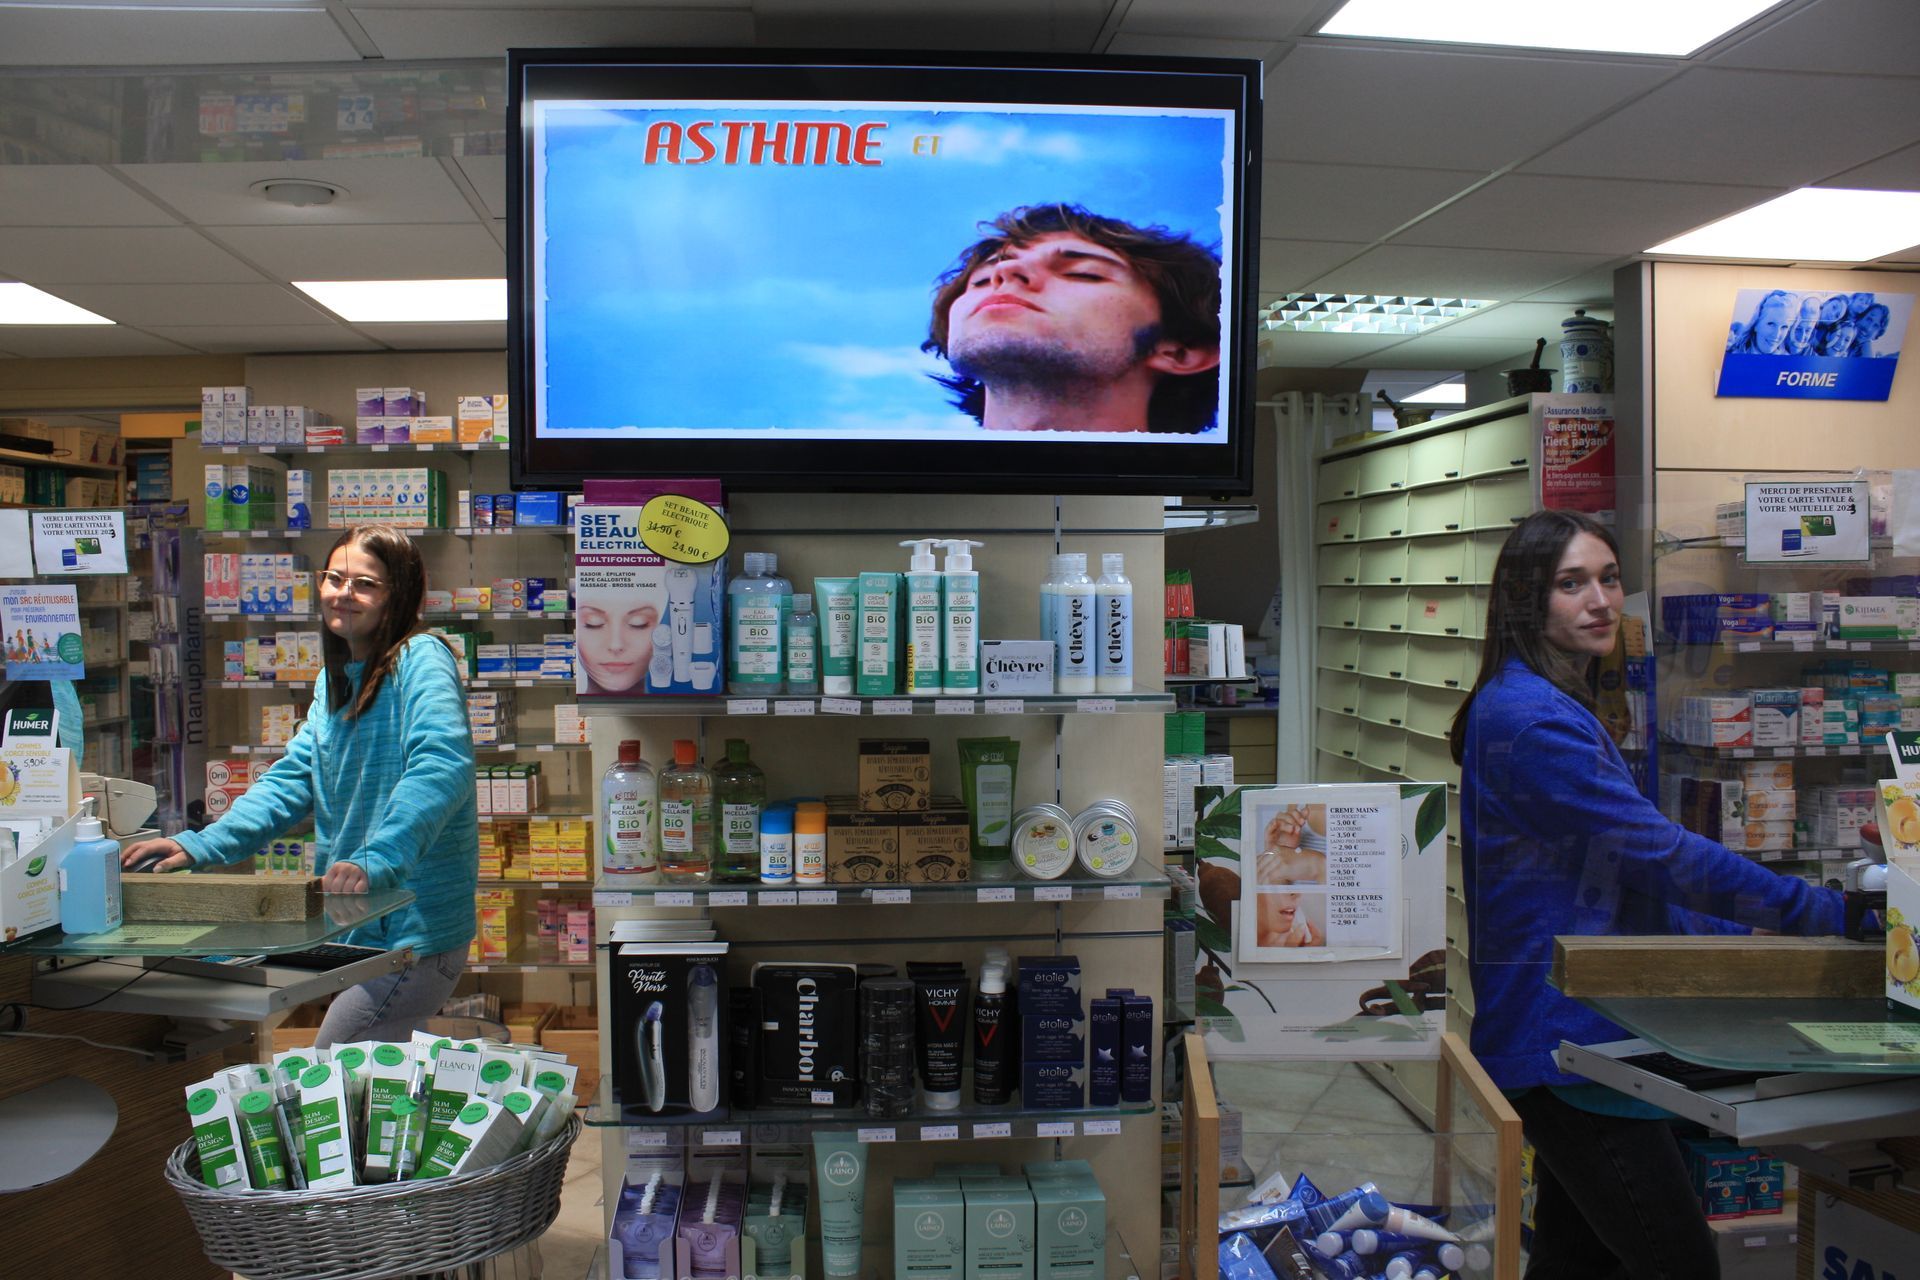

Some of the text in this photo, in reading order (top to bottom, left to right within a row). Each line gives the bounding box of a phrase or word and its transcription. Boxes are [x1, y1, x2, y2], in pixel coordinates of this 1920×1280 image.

[644, 121, 942, 166] ASTHME ET
[1776, 371, 1839, 387] FORME
[1581, 407, 1606, 415] Maladie
[1548, 421, 1600, 433] Générique
[1545, 436, 1608, 448] Tiers payant
[1760, 487, 1787, 495] MERCI
[1803, 486, 1853, 494] PRESENTER
[664, 500, 710, 521] SET BEAUTE
[580, 514, 620, 526] SET
[661, 508, 709, 530] ELECTRIQUE
[580, 526, 638, 538] BEAU
[674, 529, 682, 538] €
[671, 540, 709, 560] 24,90 €
[20, 596, 33, 605] SAC
[33, 593, 75, 604] RÉUTILISABLE
[25, 614, 76, 624] ENVIRONNEMENT
[1069, 598, 1084, 665] Chèvre
[1108, 598, 1123, 665] Chèvre
[986, 654, 1046, 674] Chèvre
[183, 606, 206, 744] manupharm
[13, 720, 49, 730] HUMER
[211, 771, 228, 780] Drill
[210, 798, 227, 806] Drill
[628, 968, 667, 983] Points
[1034, 972, 1065, 982] étoile
[633, 980, 668, 994] Noirs
[925, 988, 959, 998] VICHY
[1091, 1012, 1118, 1022] étoile
[1126, 1010, 1152, 1020] étoile
[1039, 1018, 1070, 1030] étoile
[439, 1060, 476, 1072] ELANCYL
[1038, 1066, 1069, 1078] étoile
[433, 1100, 450, 1108] SLIM
[303, 1111, 321, 1119] SLIM
[196, 1132, 213, 1142] SLIM
[440, 1139, 454, 1148] SLIM
[829, 1167, 854, 1176] LAINO
